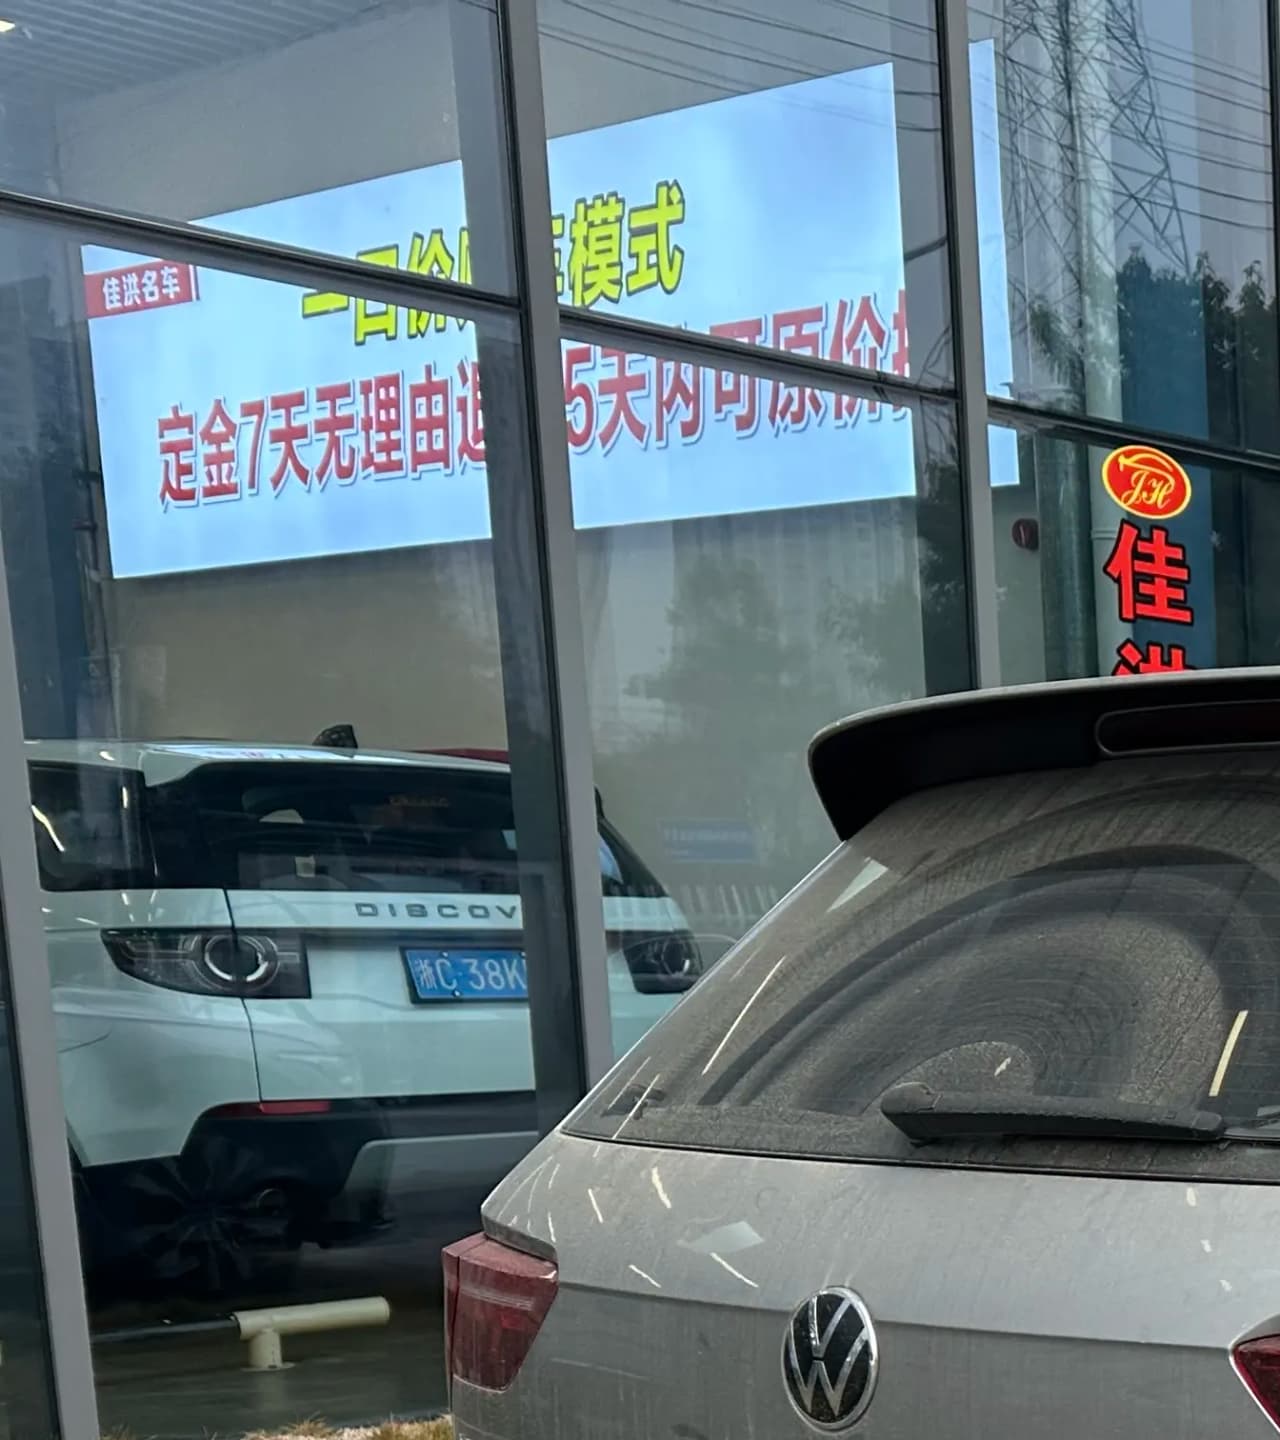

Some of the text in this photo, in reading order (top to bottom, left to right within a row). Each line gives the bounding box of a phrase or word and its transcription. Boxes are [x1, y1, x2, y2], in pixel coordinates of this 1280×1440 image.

[102, 264, 181, 311] 佳洪名车
[355, 902, 517, 919] DISCOV
